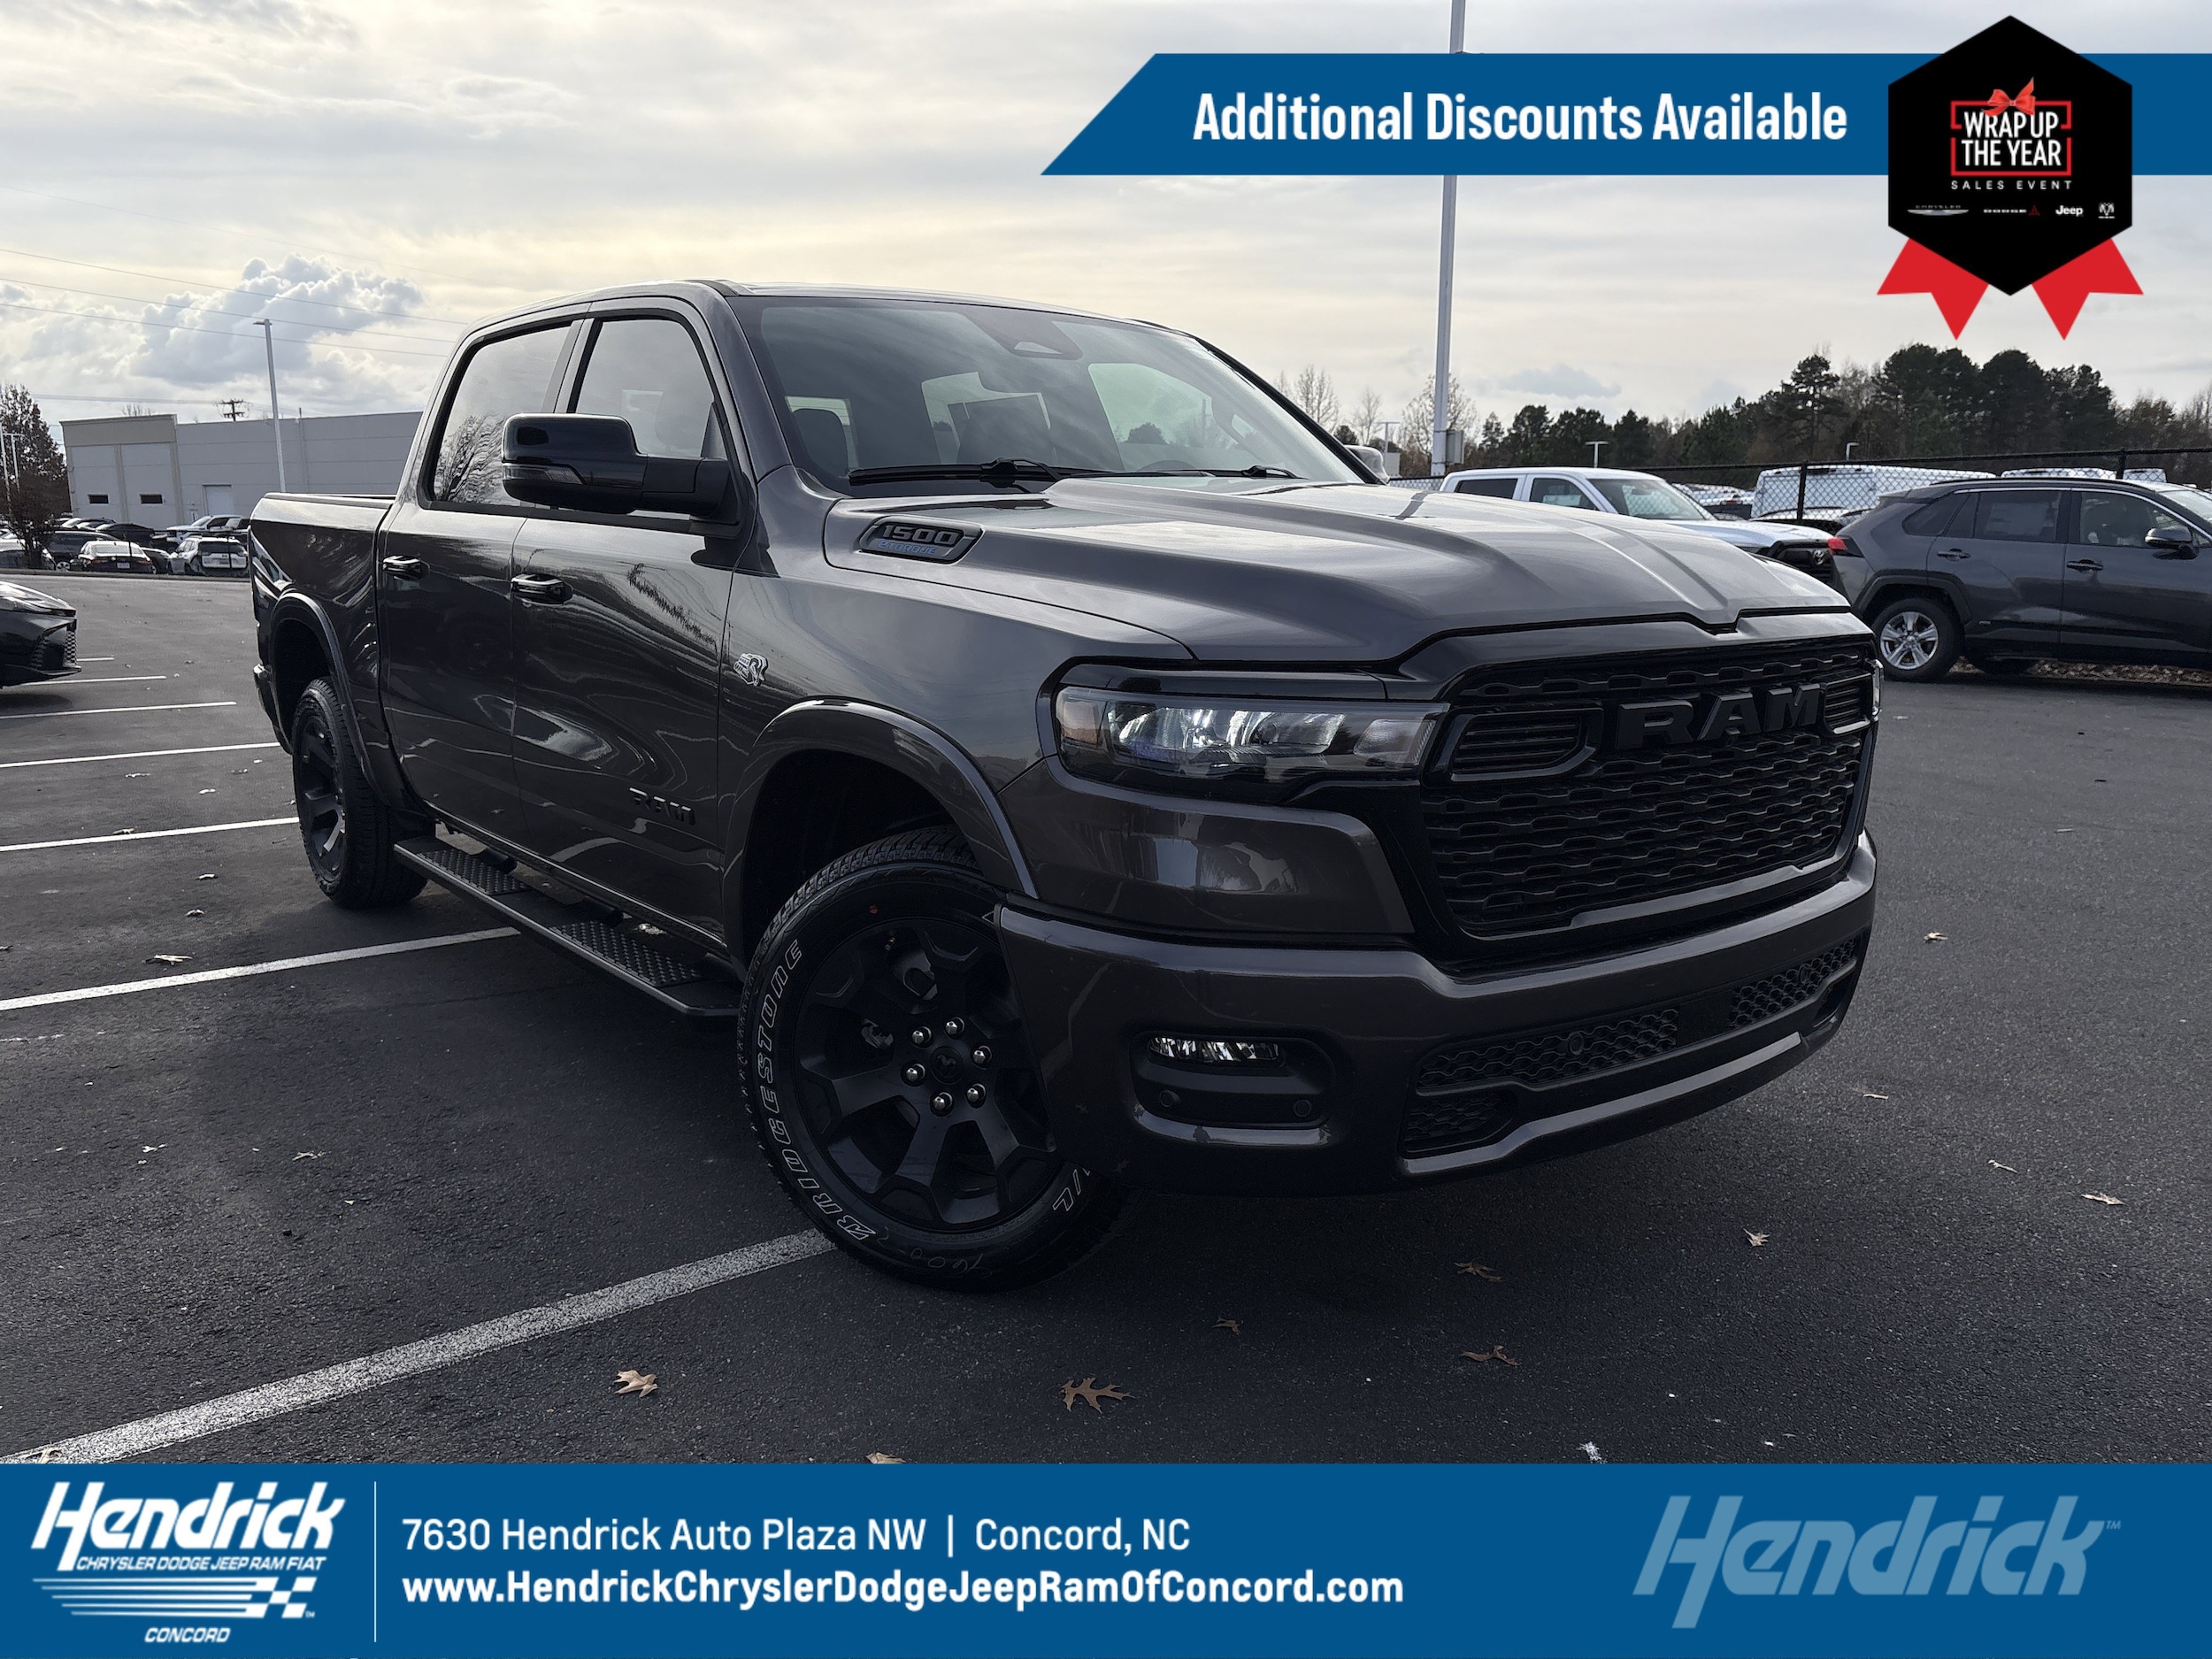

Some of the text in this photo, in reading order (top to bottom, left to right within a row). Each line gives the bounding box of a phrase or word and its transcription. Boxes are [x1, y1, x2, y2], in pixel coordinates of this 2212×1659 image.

[884, 525, 959, 545] 1500
[1616, 683, 1821, 750] RAM
[757, 938, 877, 1241] BRIDGESTONE
